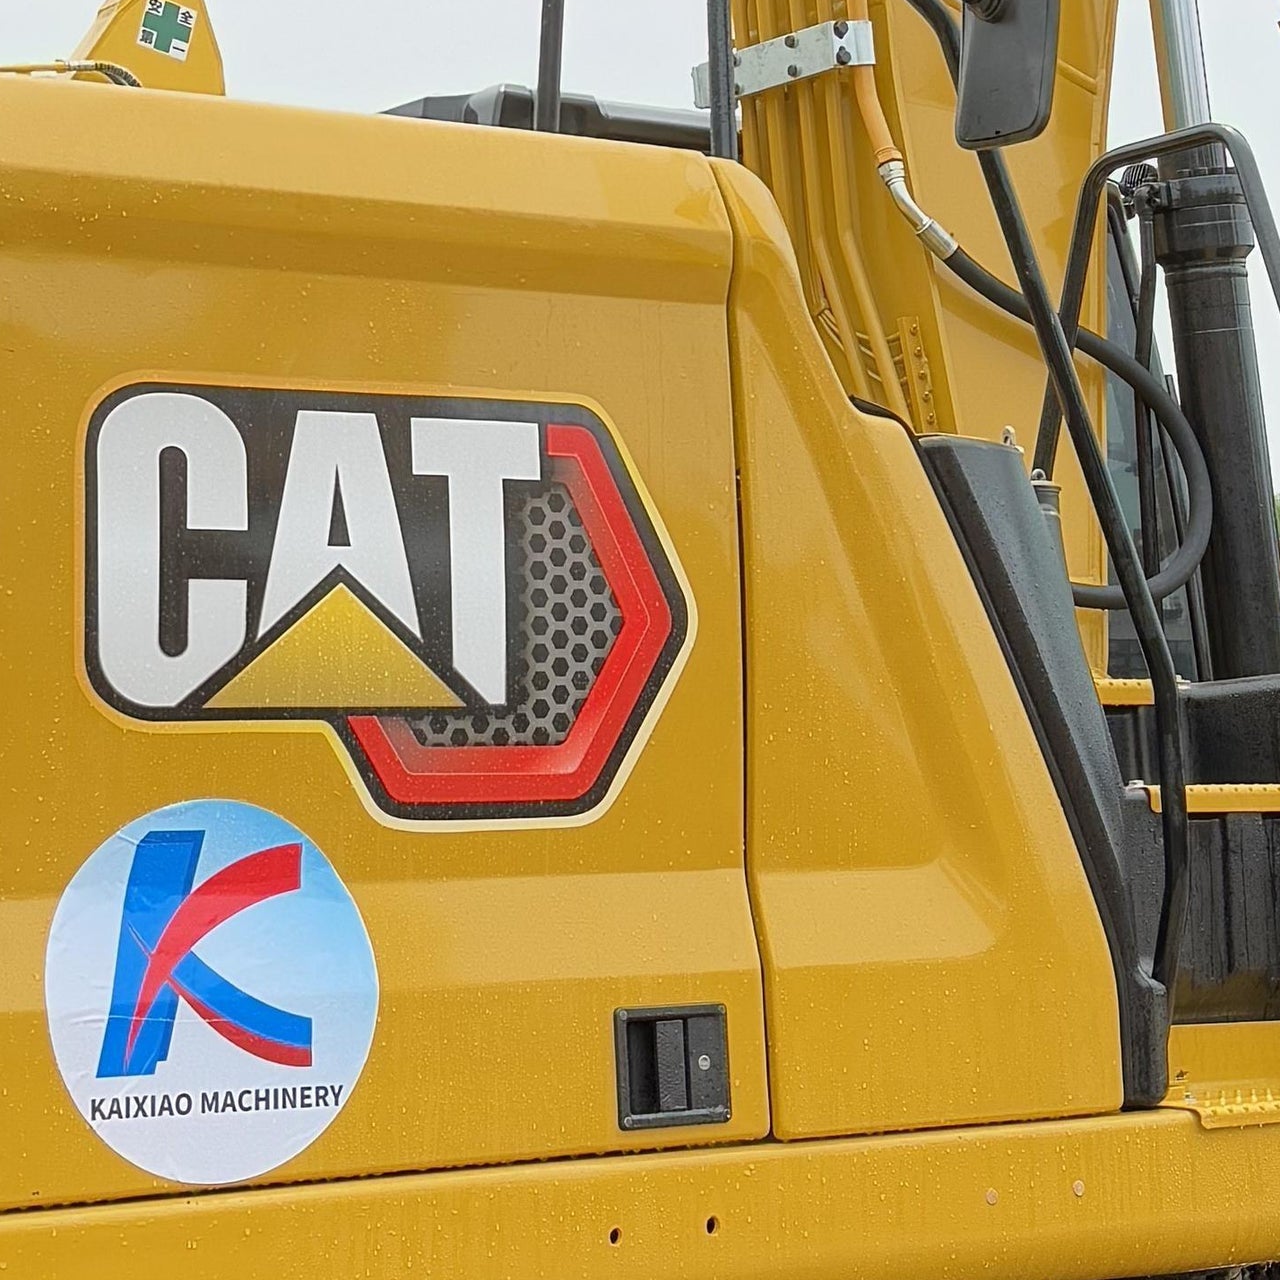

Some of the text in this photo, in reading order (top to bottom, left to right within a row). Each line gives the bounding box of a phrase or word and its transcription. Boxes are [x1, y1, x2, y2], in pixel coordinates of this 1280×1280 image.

[97, 391, 542, 709] CAT
[90, 1084, 345, 1121] KAIXIAO MACHINERY
